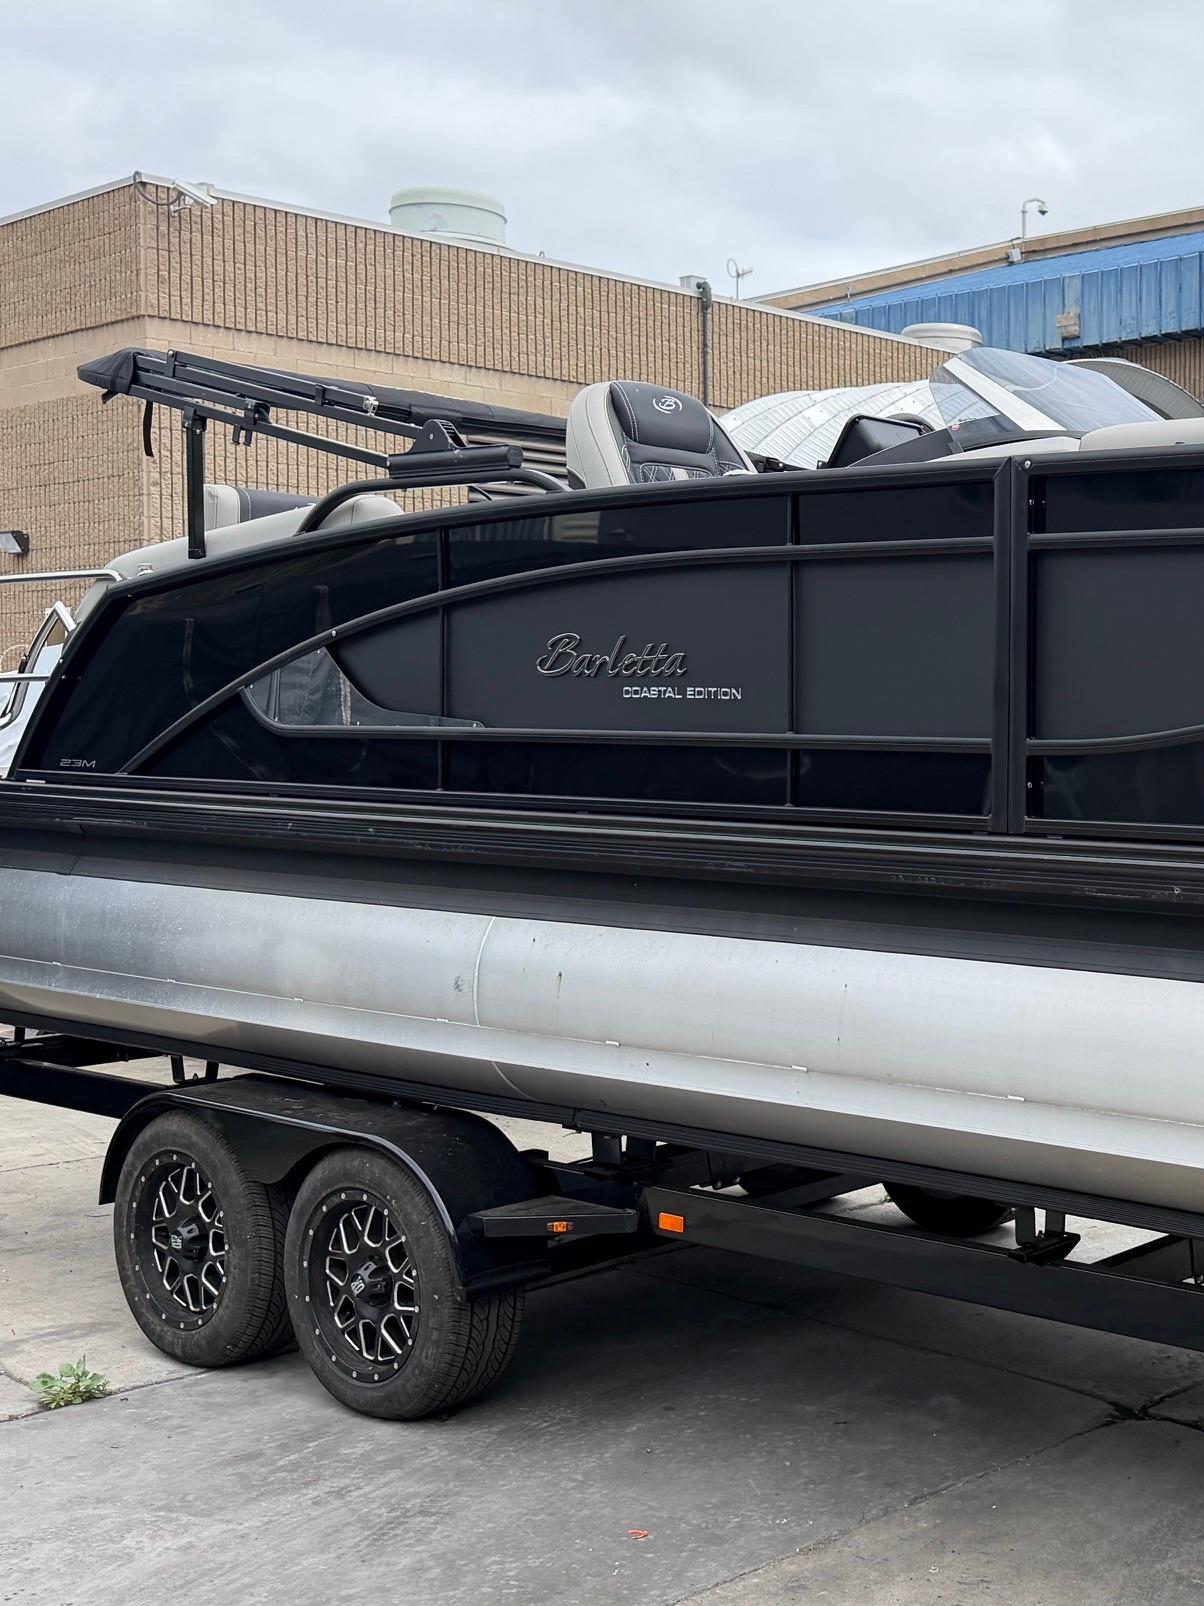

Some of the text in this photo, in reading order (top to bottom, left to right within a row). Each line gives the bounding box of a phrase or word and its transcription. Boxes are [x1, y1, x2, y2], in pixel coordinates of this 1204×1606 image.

[657, 397, 677, 411] B
[536, 632, 687, 677] Barletta
[622, 686, 742, 700] COASTAL EDITION
[60, 758, 96, 768] 23M
